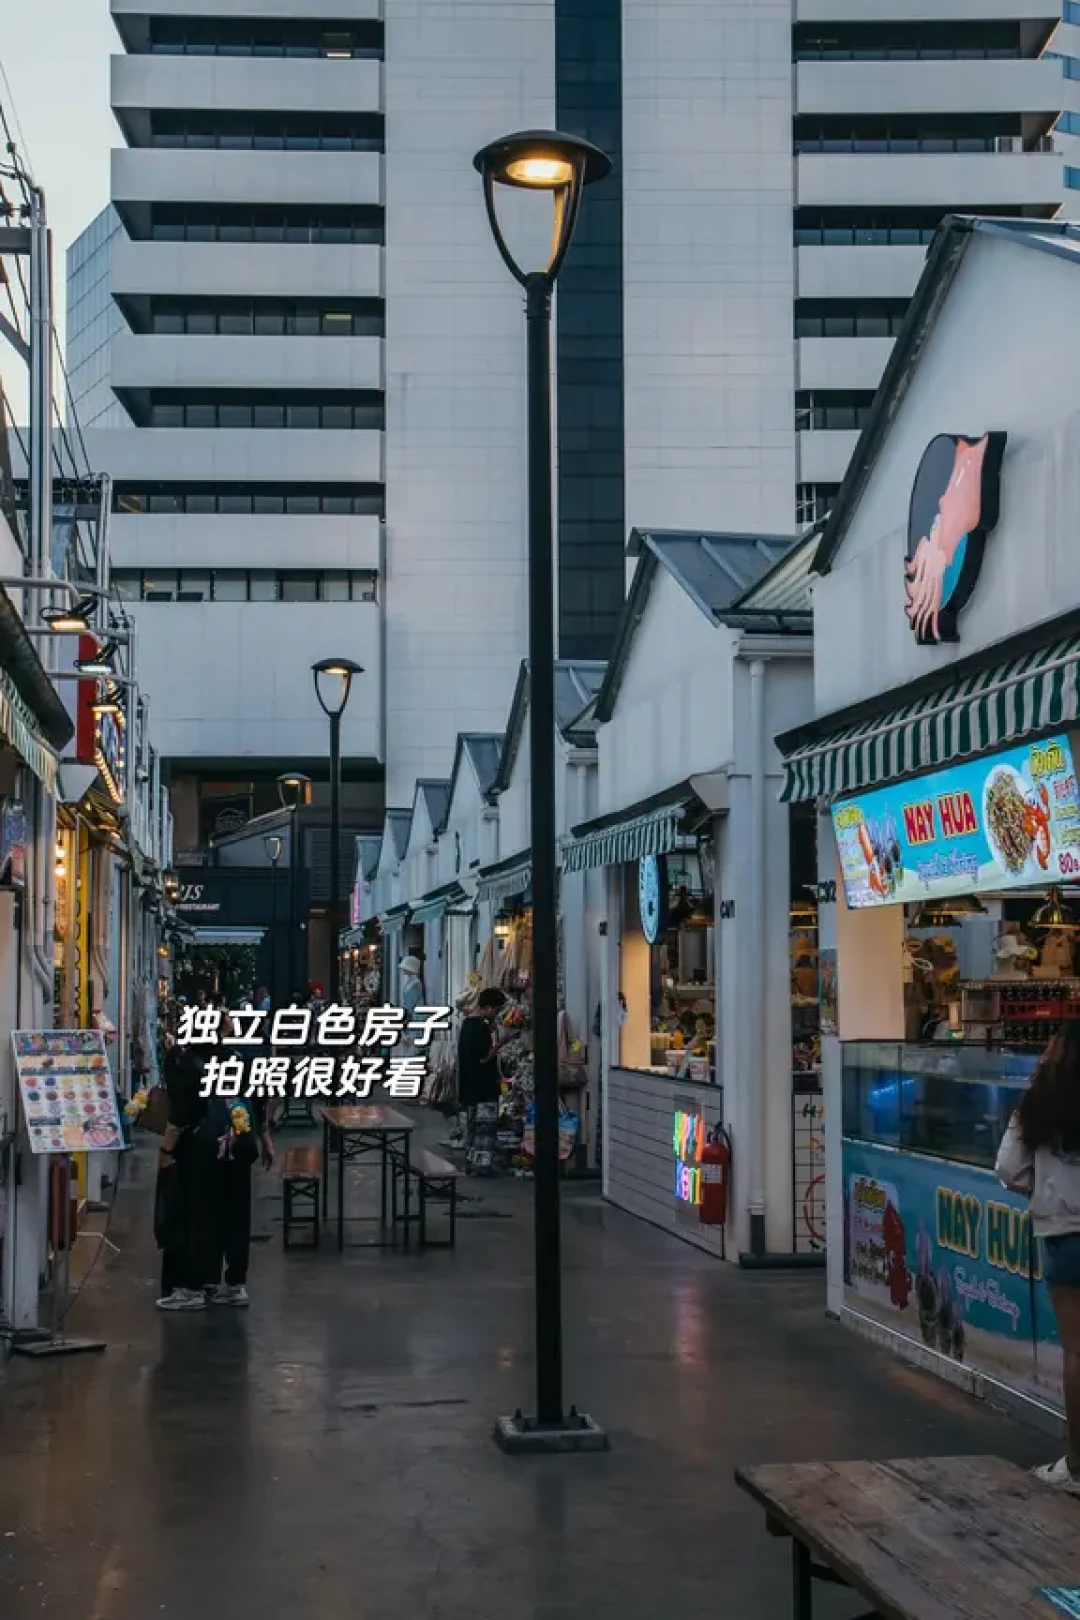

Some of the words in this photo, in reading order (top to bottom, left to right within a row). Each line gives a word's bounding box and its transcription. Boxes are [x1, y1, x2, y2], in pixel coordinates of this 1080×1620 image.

[903, 802, 935, 845] NAY
[937, 790, 978, 839] HUA
[936, 1185, 982, 1259] NAY
